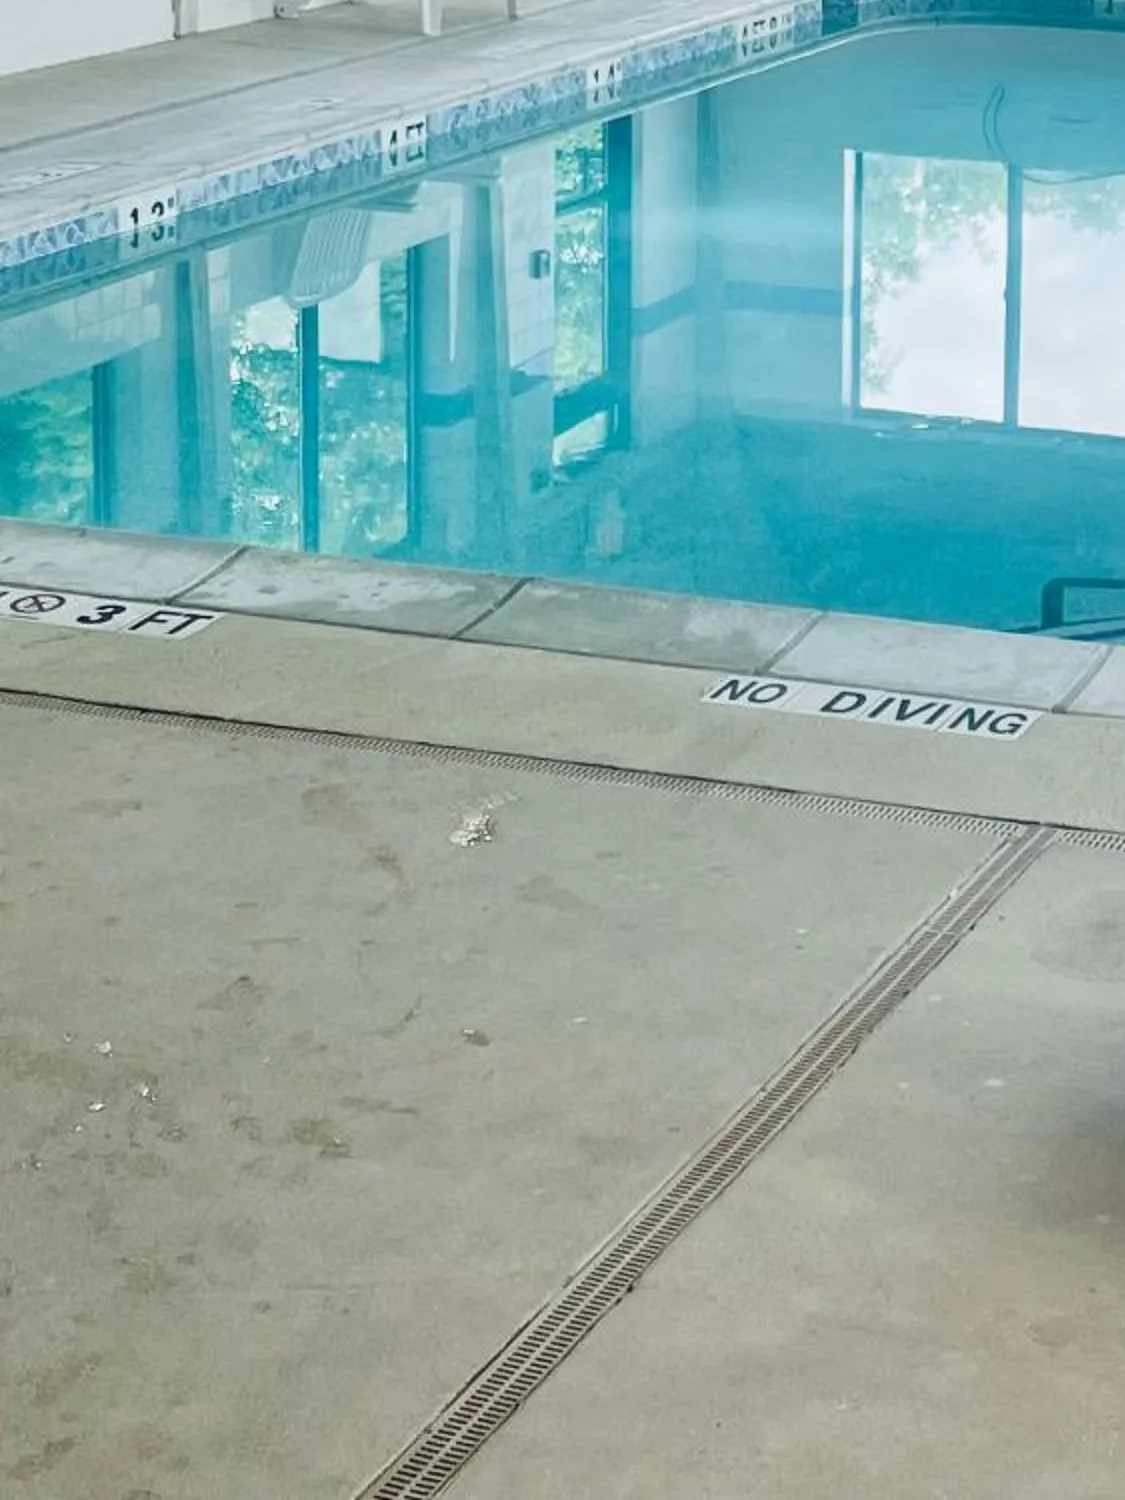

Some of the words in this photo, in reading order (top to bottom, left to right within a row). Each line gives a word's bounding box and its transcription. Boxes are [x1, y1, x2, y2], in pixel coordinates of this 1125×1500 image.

[76, 604, 128, 625] 3
[127, 609, 214, 635] FT
[710, 678, 788, 704] NO
[819, 690, 1028, 736] DIVING
